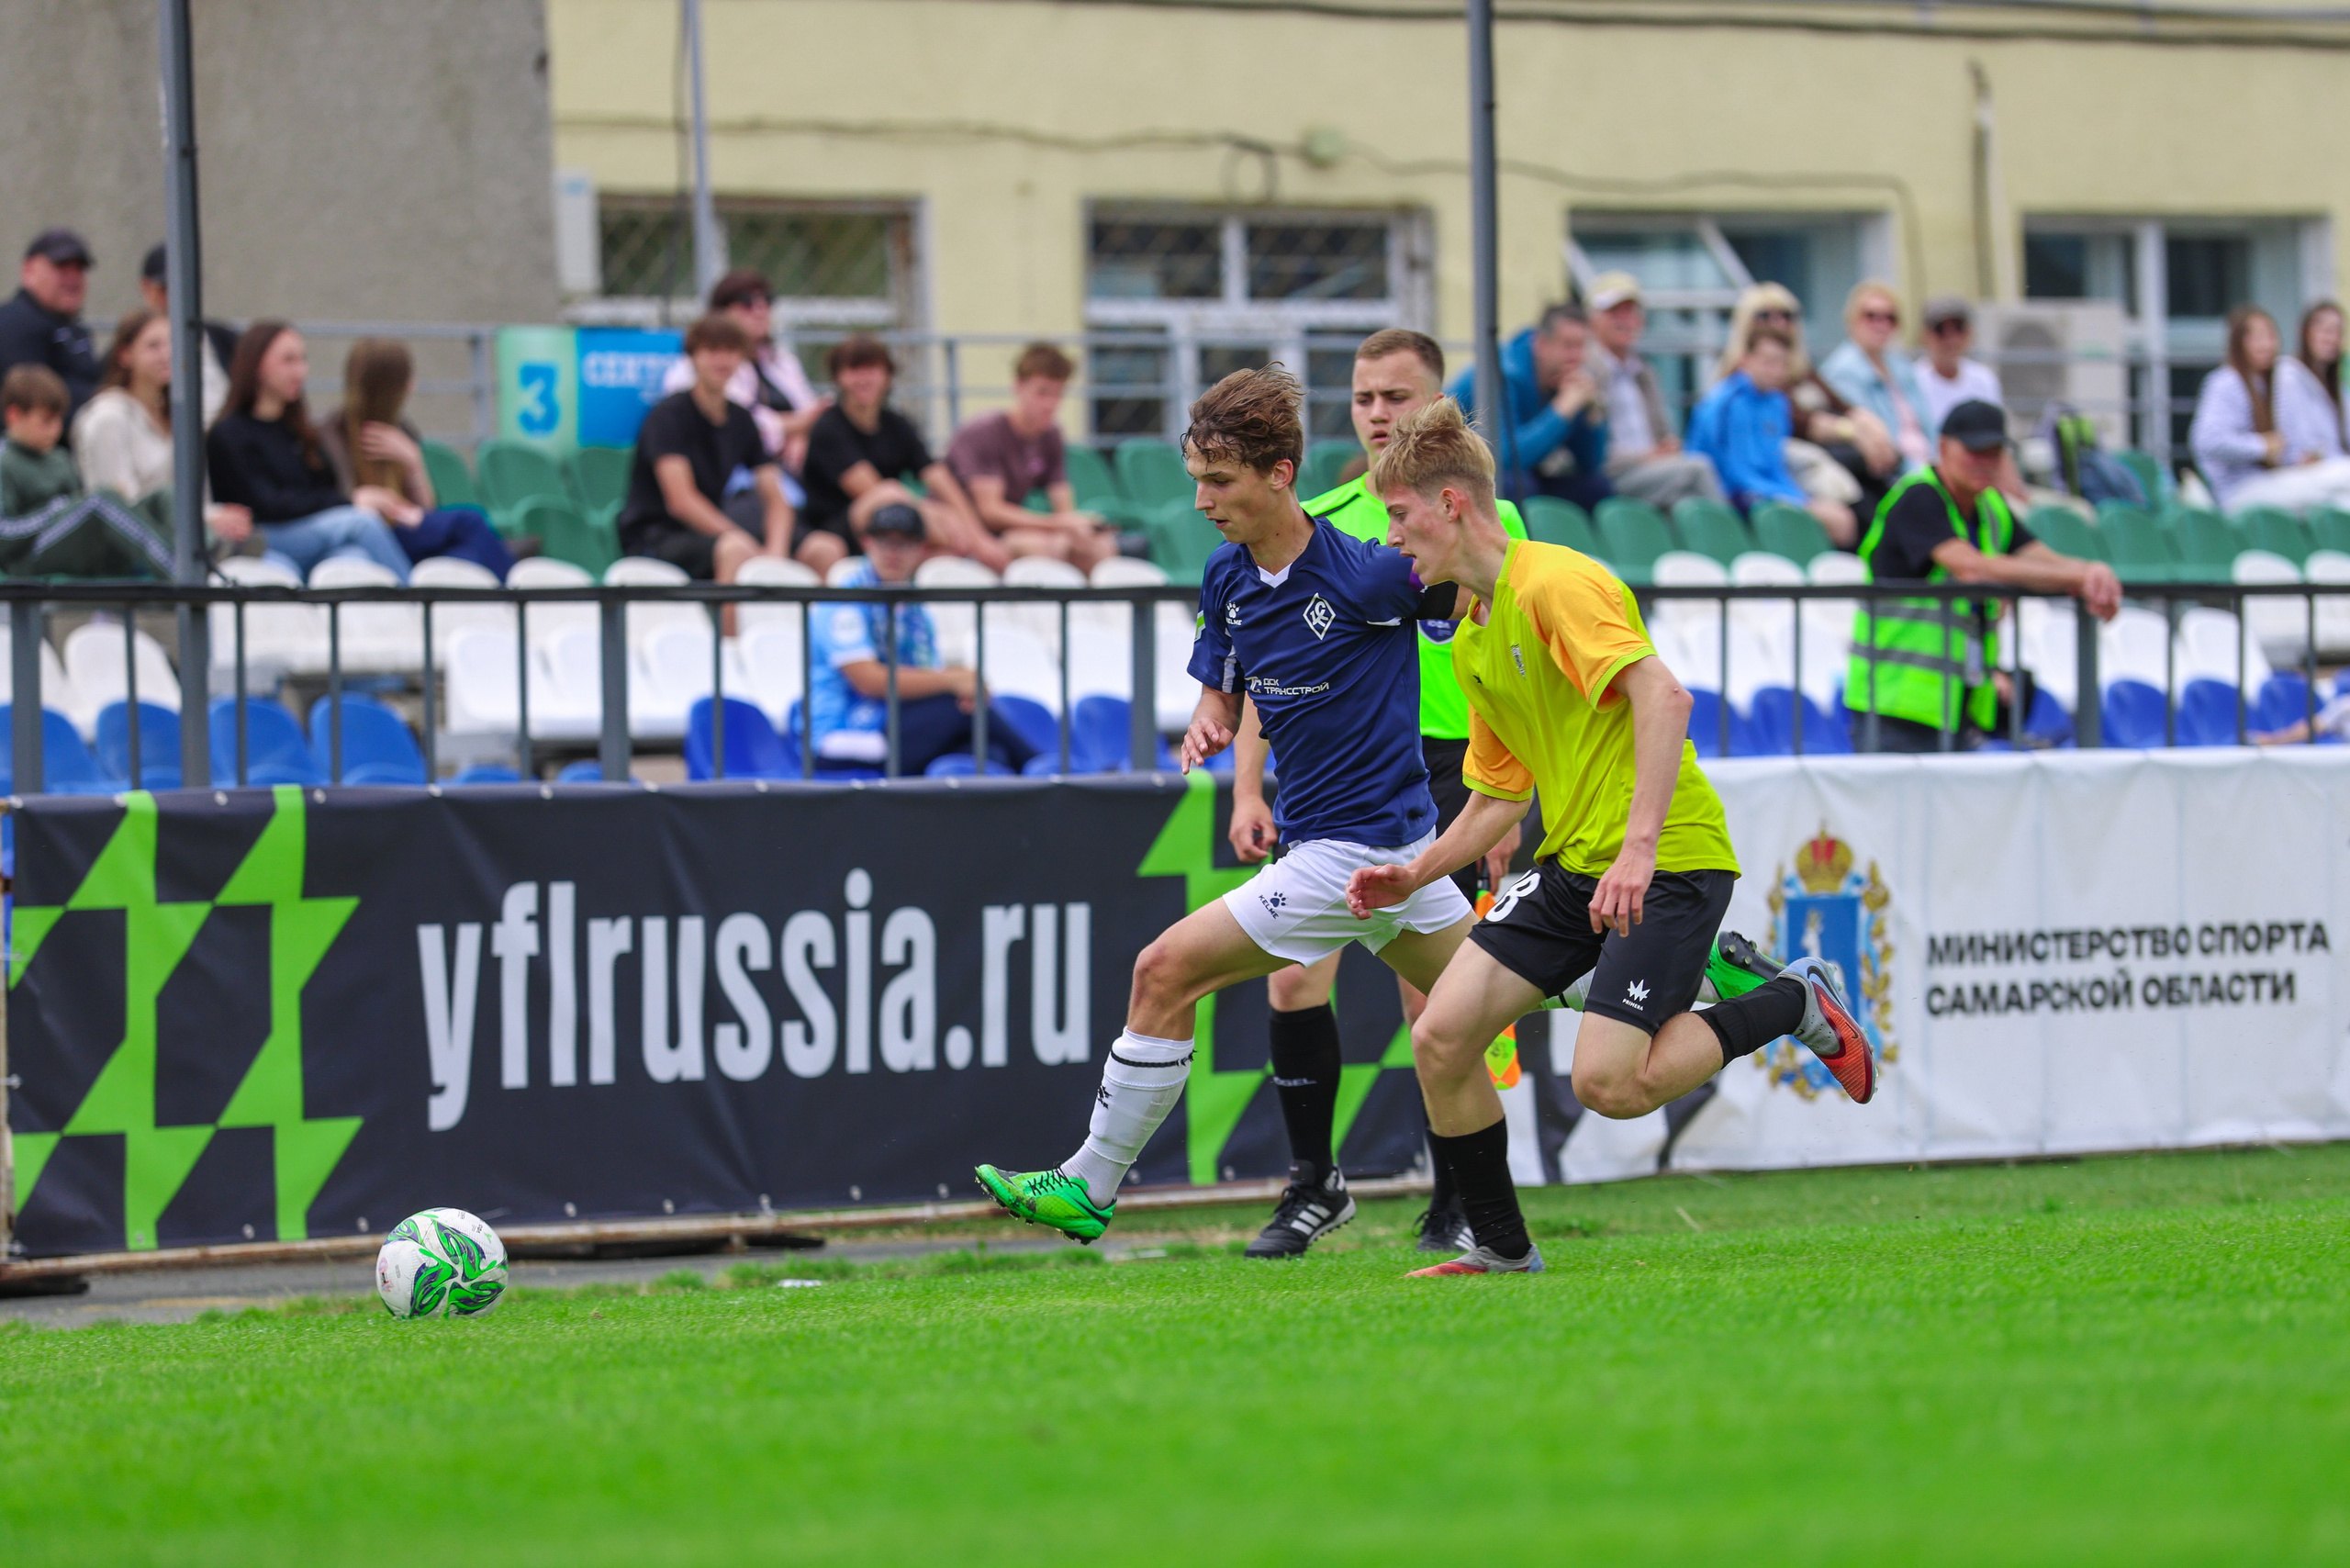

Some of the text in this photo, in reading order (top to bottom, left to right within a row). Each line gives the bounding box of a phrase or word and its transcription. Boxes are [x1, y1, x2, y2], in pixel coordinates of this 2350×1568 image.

[519, 364, 560, 437] 3
[1263, 681, 1330, 696] ТРАНССТРОЙ
[1259, 894, 1280, 920] KELME
[1484, 868, 1541, 923] 8
[1928, 921, 2331, 964] МИНИСТЕРСТВО СПОРТА
[417, 868, 1091, 1132] yflrussia.ru
[1621, 998, 1644, 1012] PRIMERA
[1927, 967, 2297, 1016] САМАРСКОЙ ОБЛАСТИ
